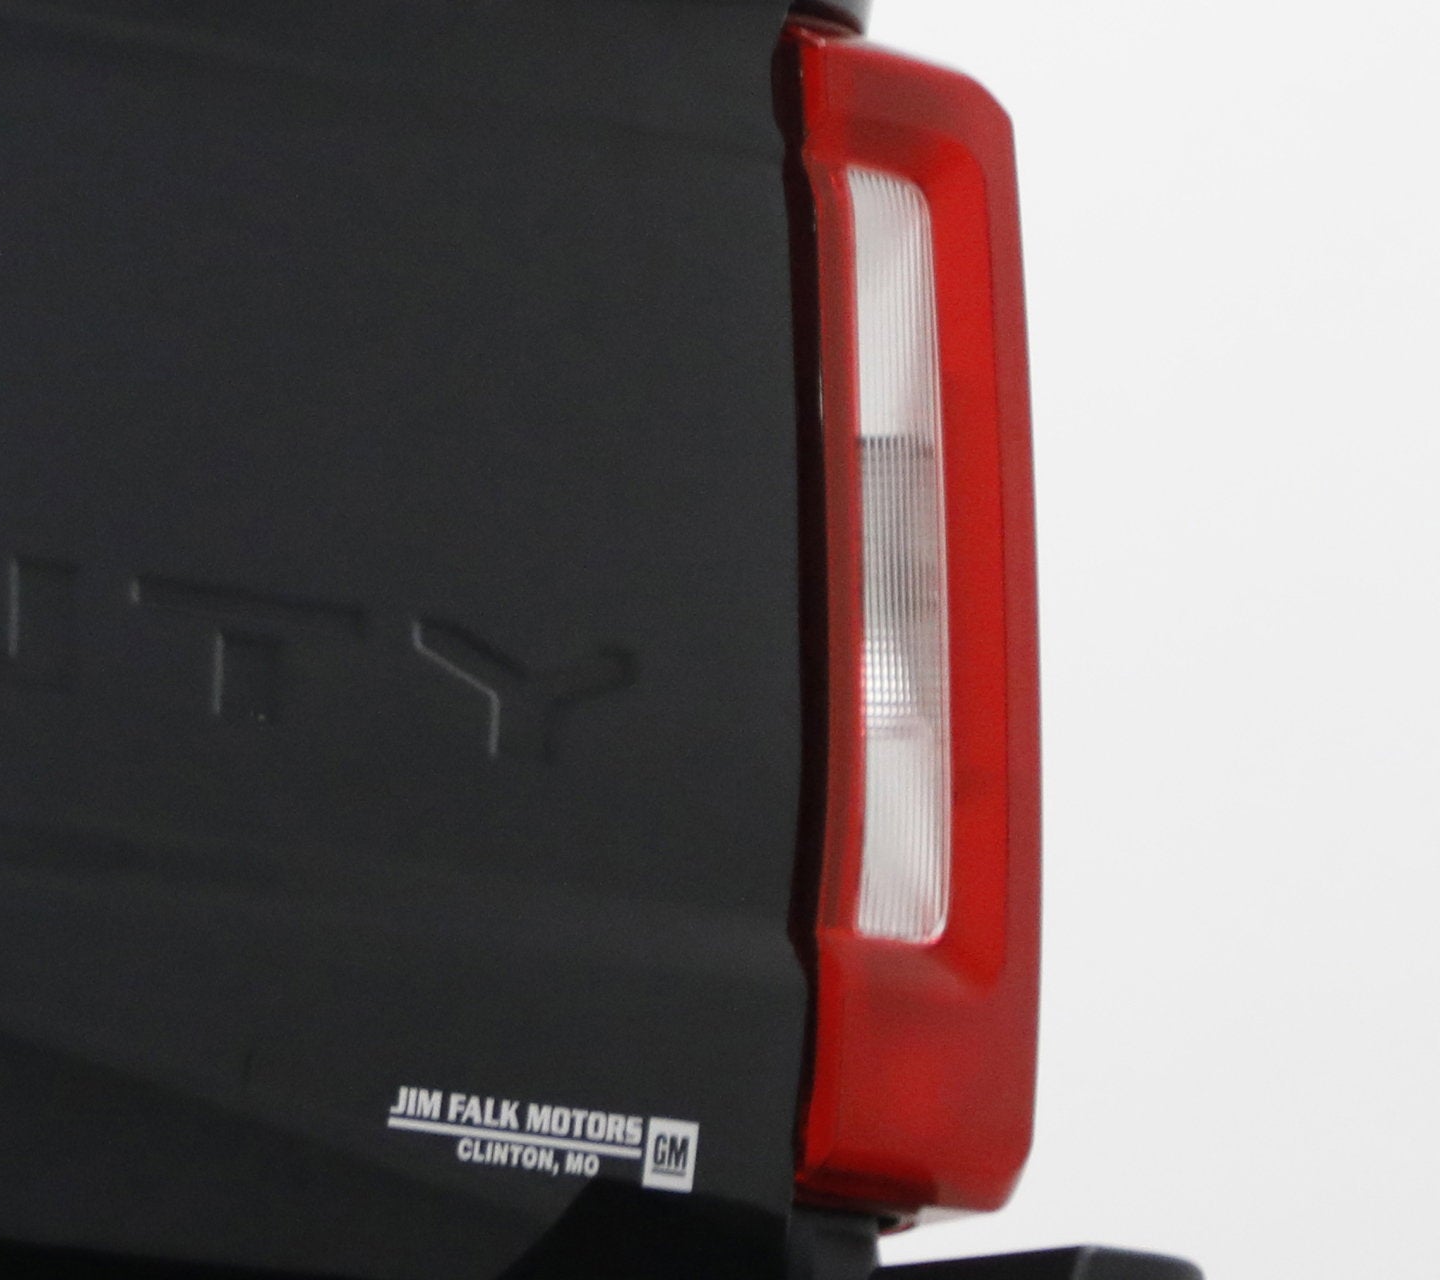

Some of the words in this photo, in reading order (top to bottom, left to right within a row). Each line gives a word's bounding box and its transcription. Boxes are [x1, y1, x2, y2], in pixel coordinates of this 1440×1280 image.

[389, 1085, 443, 1120] JIM
[446, 1092, 521, 1130] FALK
[526, 1102, 645, 1147] MOTORS
[651, 1132, 691, 1173] GM
[456, 1137, 559, 1176] CLINTON,
[565, 1151, 601, 1178] MO
